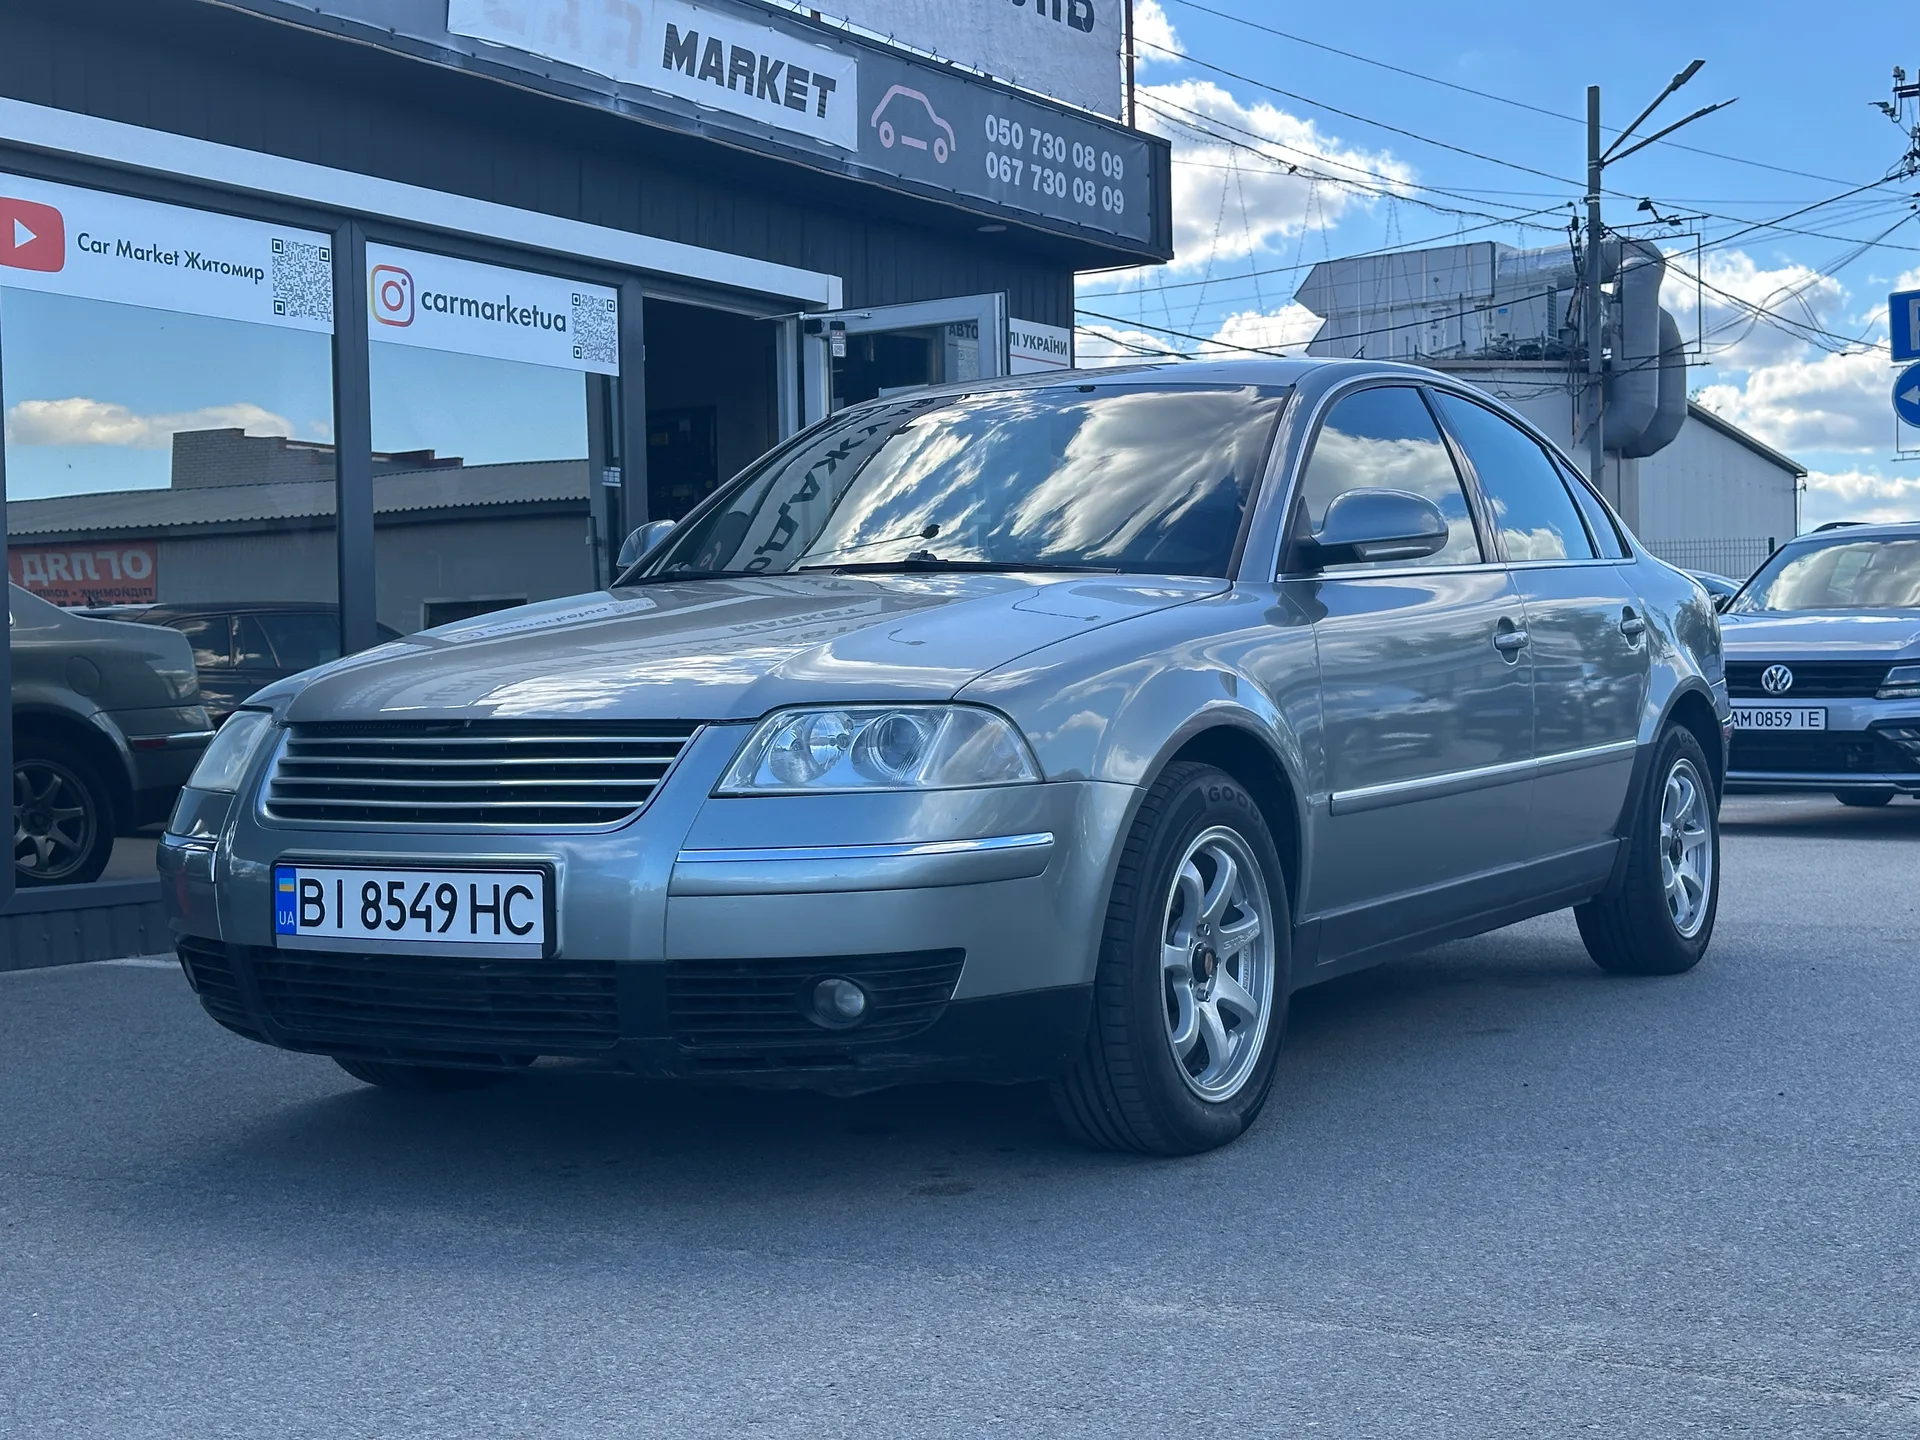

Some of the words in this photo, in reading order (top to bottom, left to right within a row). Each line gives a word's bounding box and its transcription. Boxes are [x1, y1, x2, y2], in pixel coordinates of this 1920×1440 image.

[662, 22, 837, 119] MARKET
[985, 114, 1023, 149] 050
[1030, 128, 1066, 162] 730
[1072, 142, 1096, 172] 08
[1101, 151, 1124, 180] 09
[985, 151, 1023, 186] 067
[1030, 164, 1066, 198] 730
[1073, 177, 1096, 207] 08
[1102, 185, 1124, 215] 09
[77, 232, 110, 254] Car
[116, 238, 179, 266] Market
[184, 250, 265, 285] Житомир
[421, 291, 567, 333] carmarketua
[1022, 333, 1068, 356] УКРАЇНИ
[1732, 711, 1752, 727] AM
[1756, 711, 1792, 727] 0859
[1800, 711, 1820, 727] IE
[279, 911, 295, 926] UA
[299, 878, 344, 929] BI
[361, 880, 459, 934] 8549
[470, 883, 536, 936] HC
